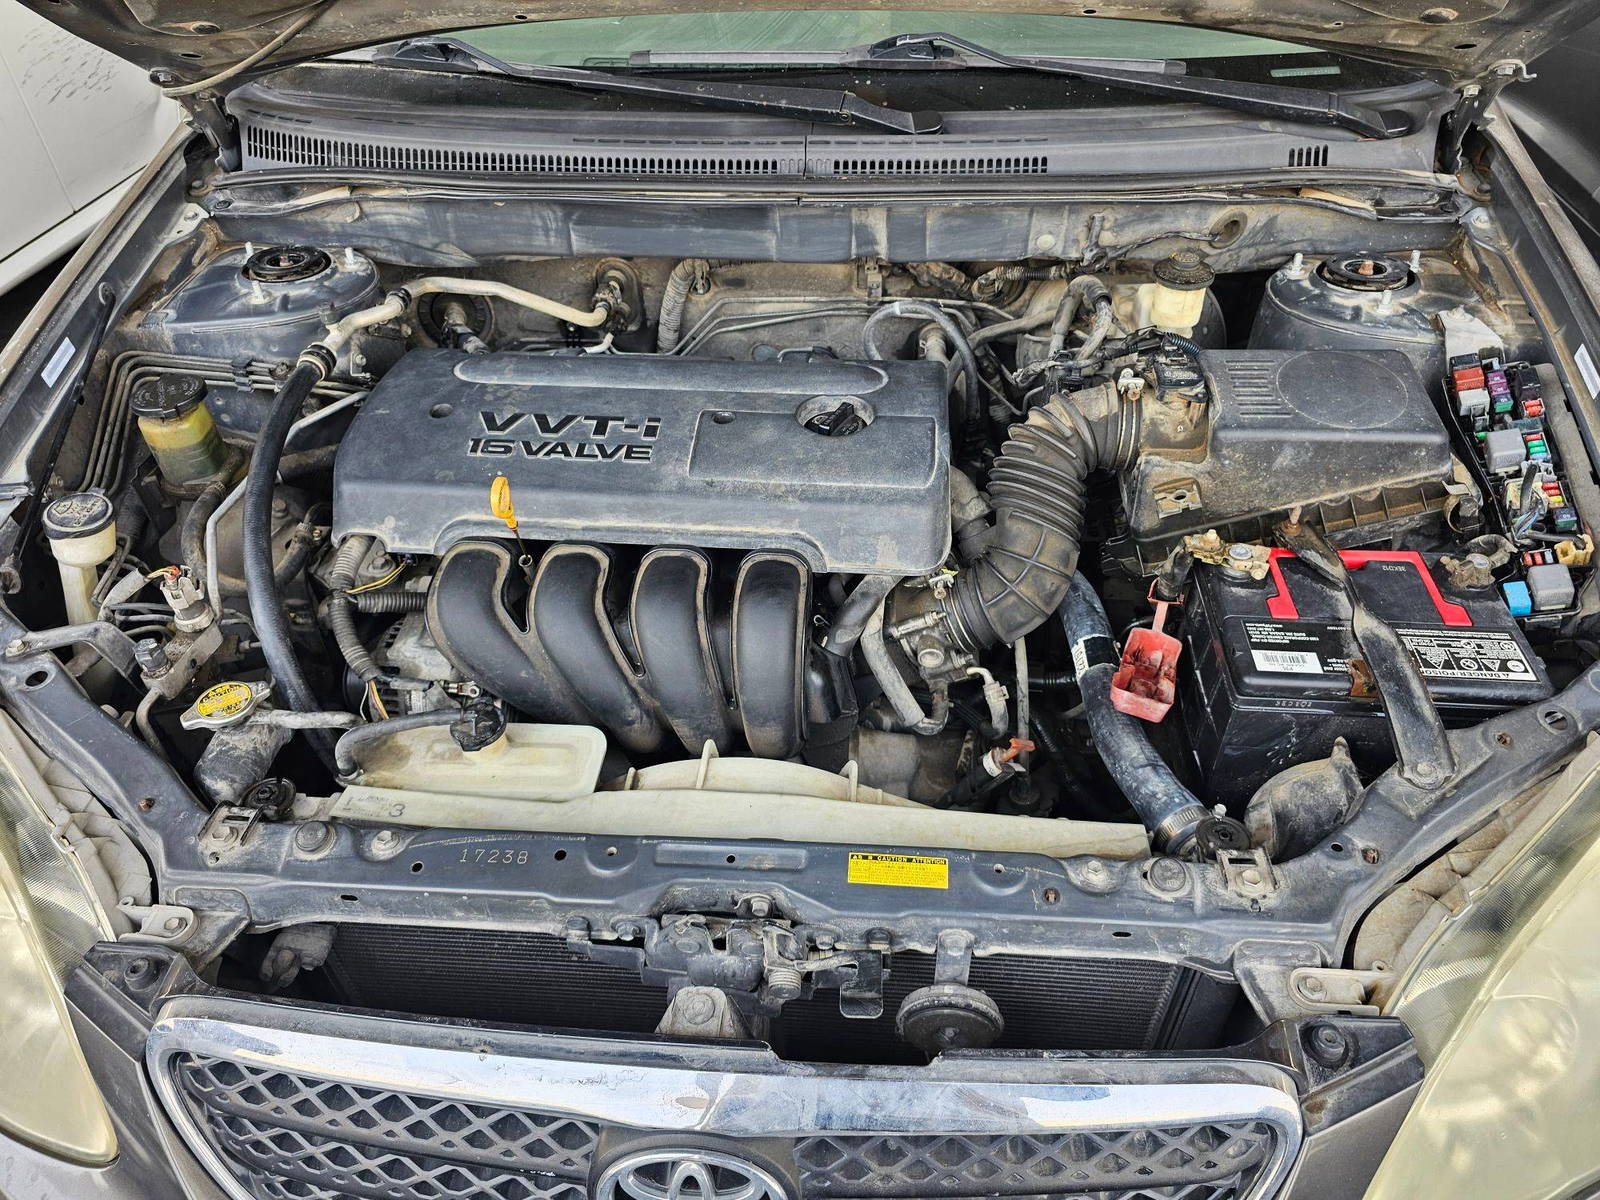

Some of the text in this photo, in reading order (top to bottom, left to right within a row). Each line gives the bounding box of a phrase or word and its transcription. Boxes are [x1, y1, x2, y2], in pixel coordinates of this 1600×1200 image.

[479, 410, 662, 440] VVT-i
[467, 437, 653, 464] 16 VALVE
[459, 848, 529, 865] 17238
